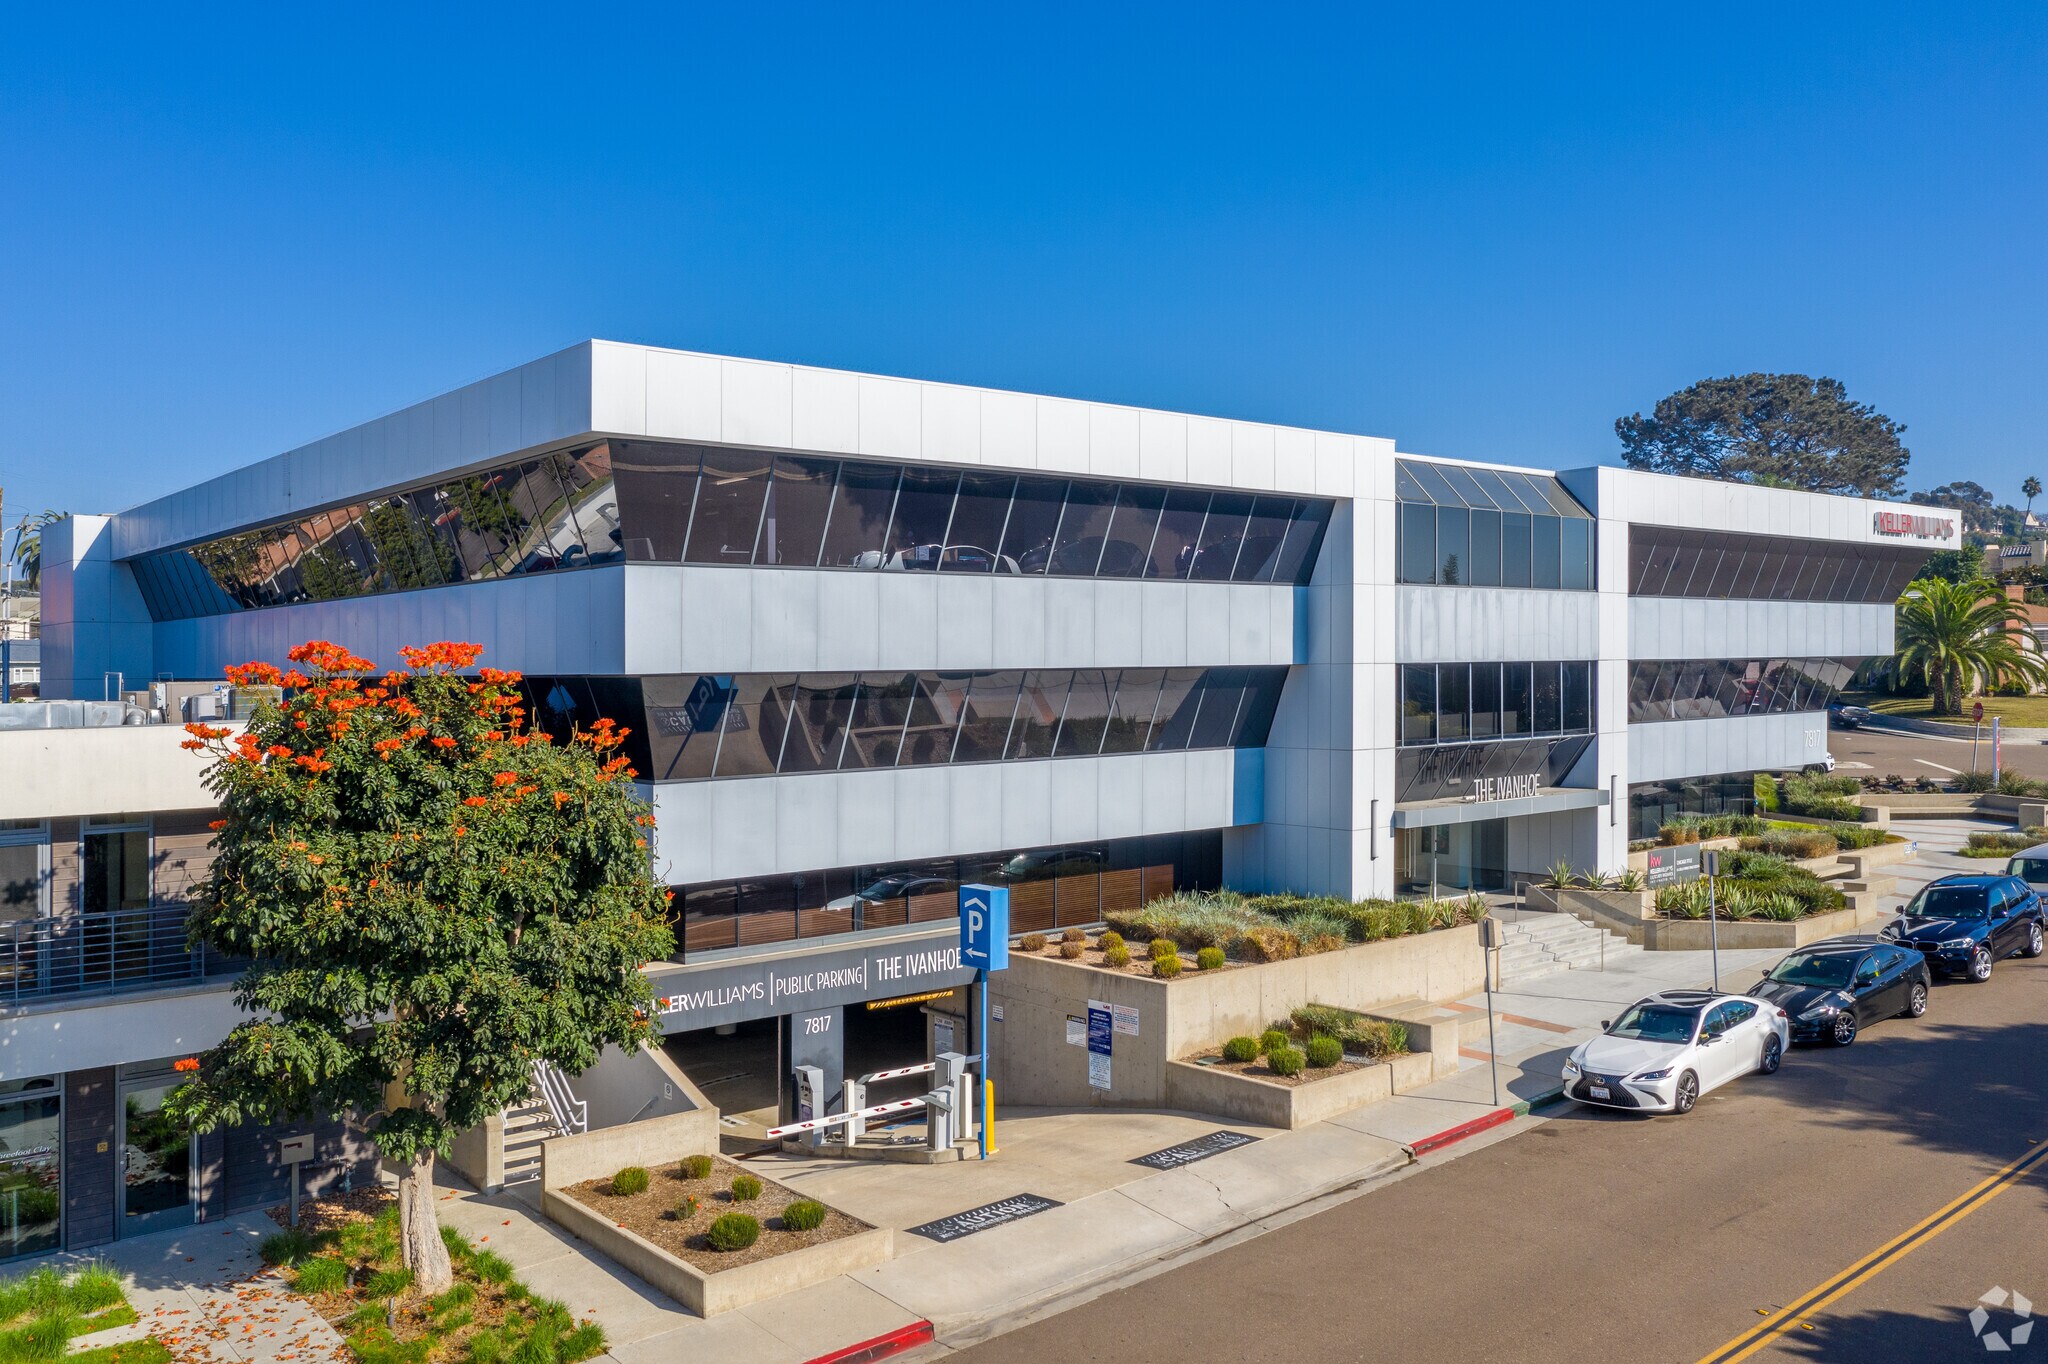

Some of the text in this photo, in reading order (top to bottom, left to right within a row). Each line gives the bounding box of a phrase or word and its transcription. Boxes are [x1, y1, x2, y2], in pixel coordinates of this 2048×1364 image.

[1474, 774, 1540, 802] THE IVANHOE
[968, 909, 983, 944] P
[776, 973, 814, 997] PUBLIC
[816, 966, 862, 990] PARKING
[876, 956, 902, 981] THE
[906, 947, 963, 977] IVANHOE
[804, 1015, 831, 1035] 7817
[33, 1145, 52, 1153] Clay
[944, 1201, 1030, 1232] CAUTION
